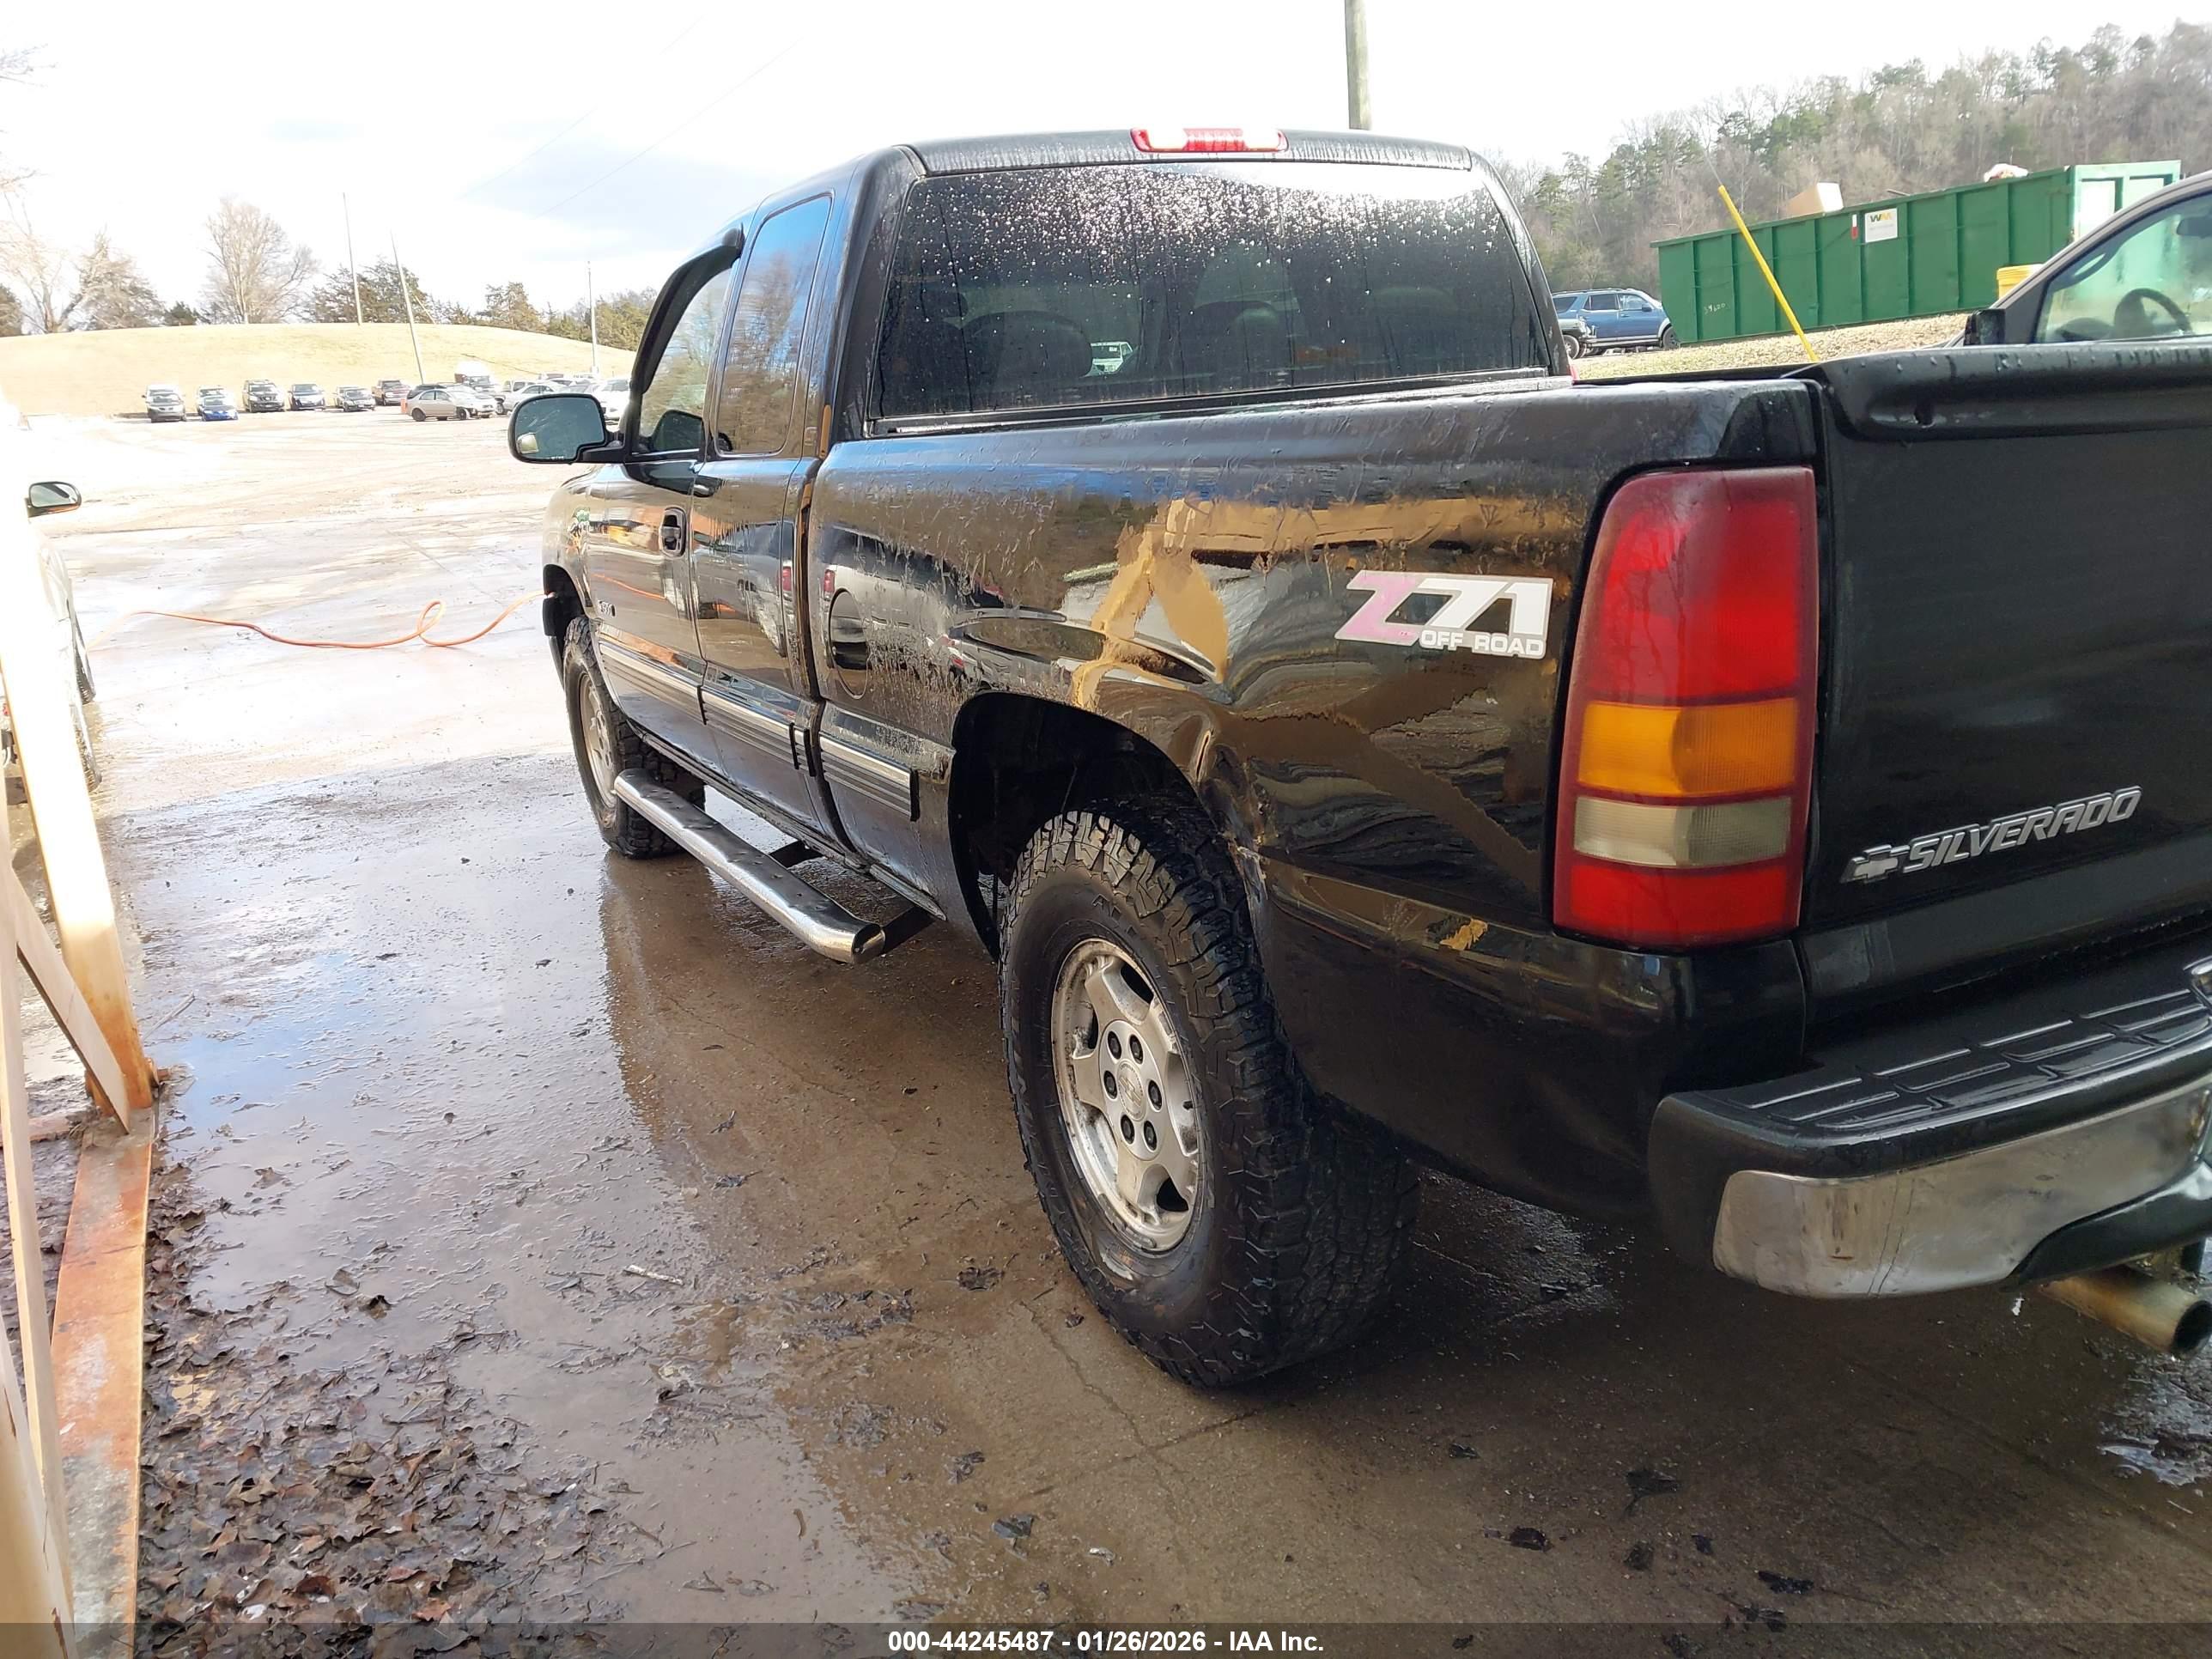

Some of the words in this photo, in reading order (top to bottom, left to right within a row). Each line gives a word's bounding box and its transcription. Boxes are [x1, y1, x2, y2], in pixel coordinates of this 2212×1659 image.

[1335, 570, 1553, 646] Z71
[1420, 629, 1464, 648] OFF
[1474, 634, 1545, 656] ROAD
[1902, 785, 2142, 874] SILVERADO
